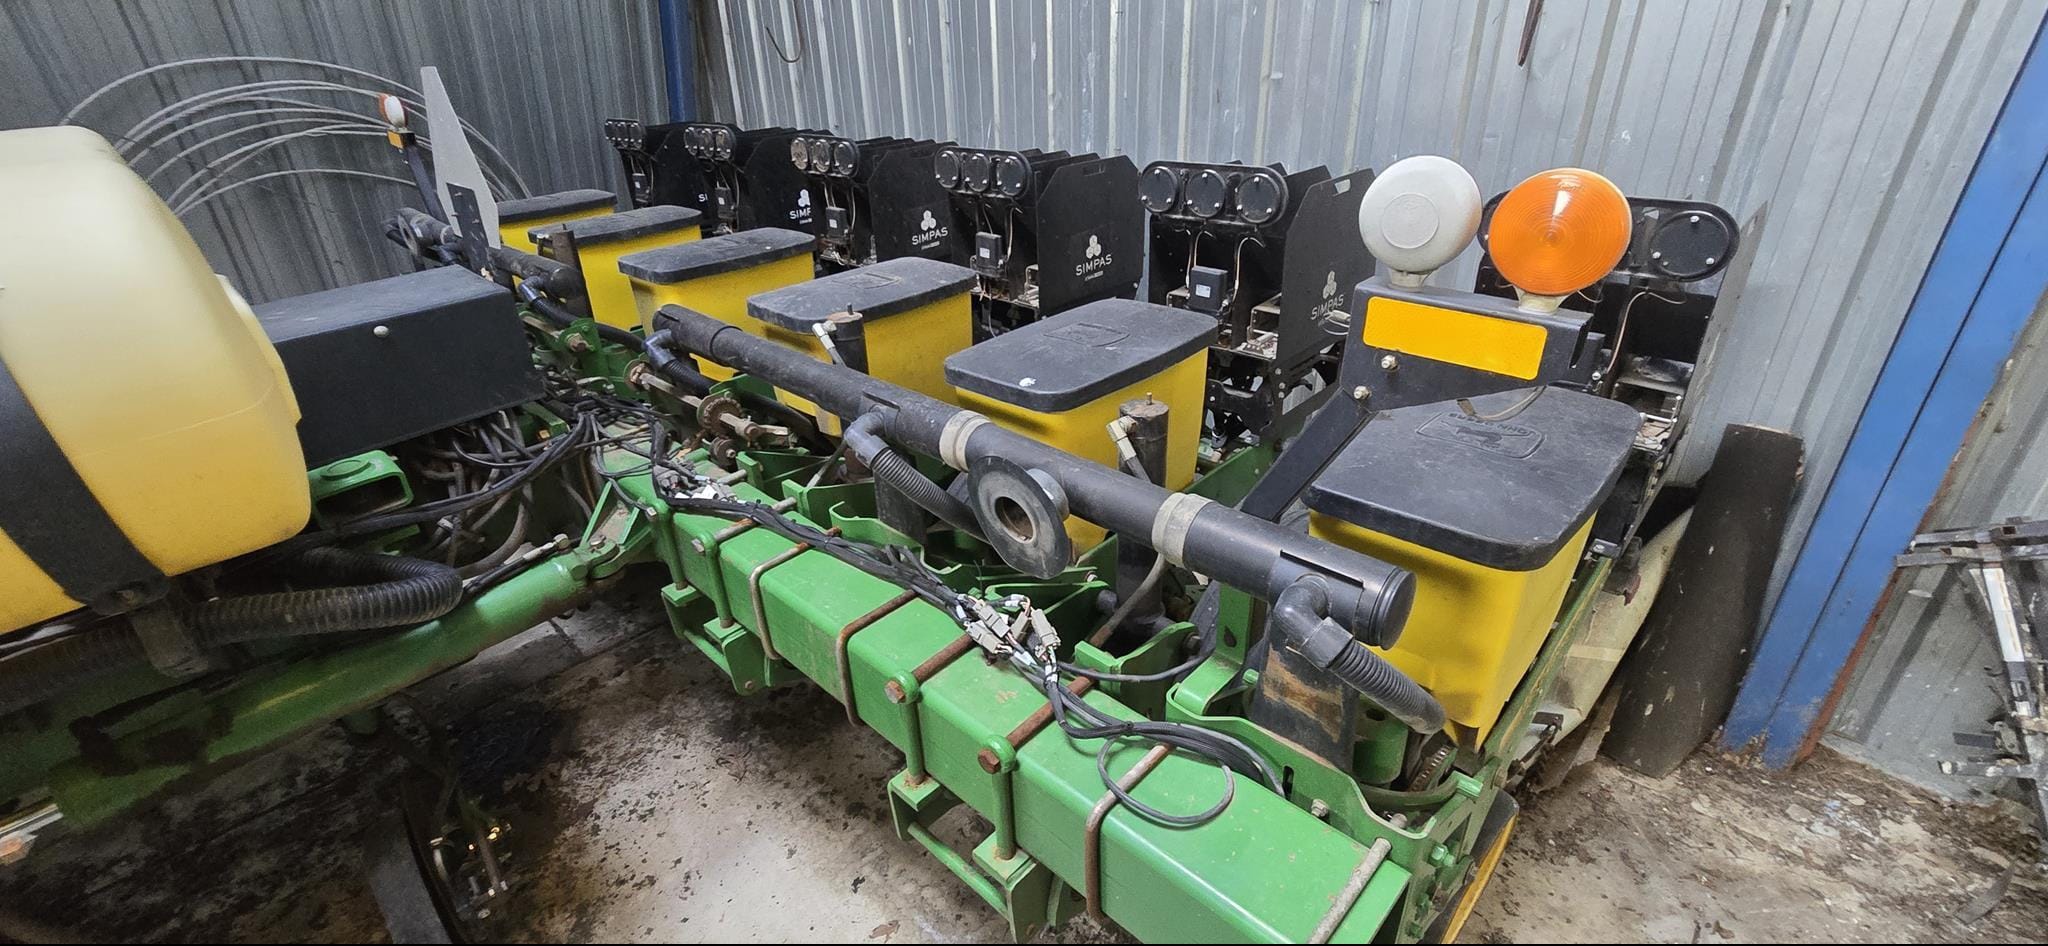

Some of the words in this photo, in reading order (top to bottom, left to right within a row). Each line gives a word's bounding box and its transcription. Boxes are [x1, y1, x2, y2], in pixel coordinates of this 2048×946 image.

[790, 207, 811, 219] SIMP
[912, 227, 948, 245] SIMPAS
[1075, 254, 1112, 276] SIMPAS
[1311, 294, 1344, 320] SIMPAS
